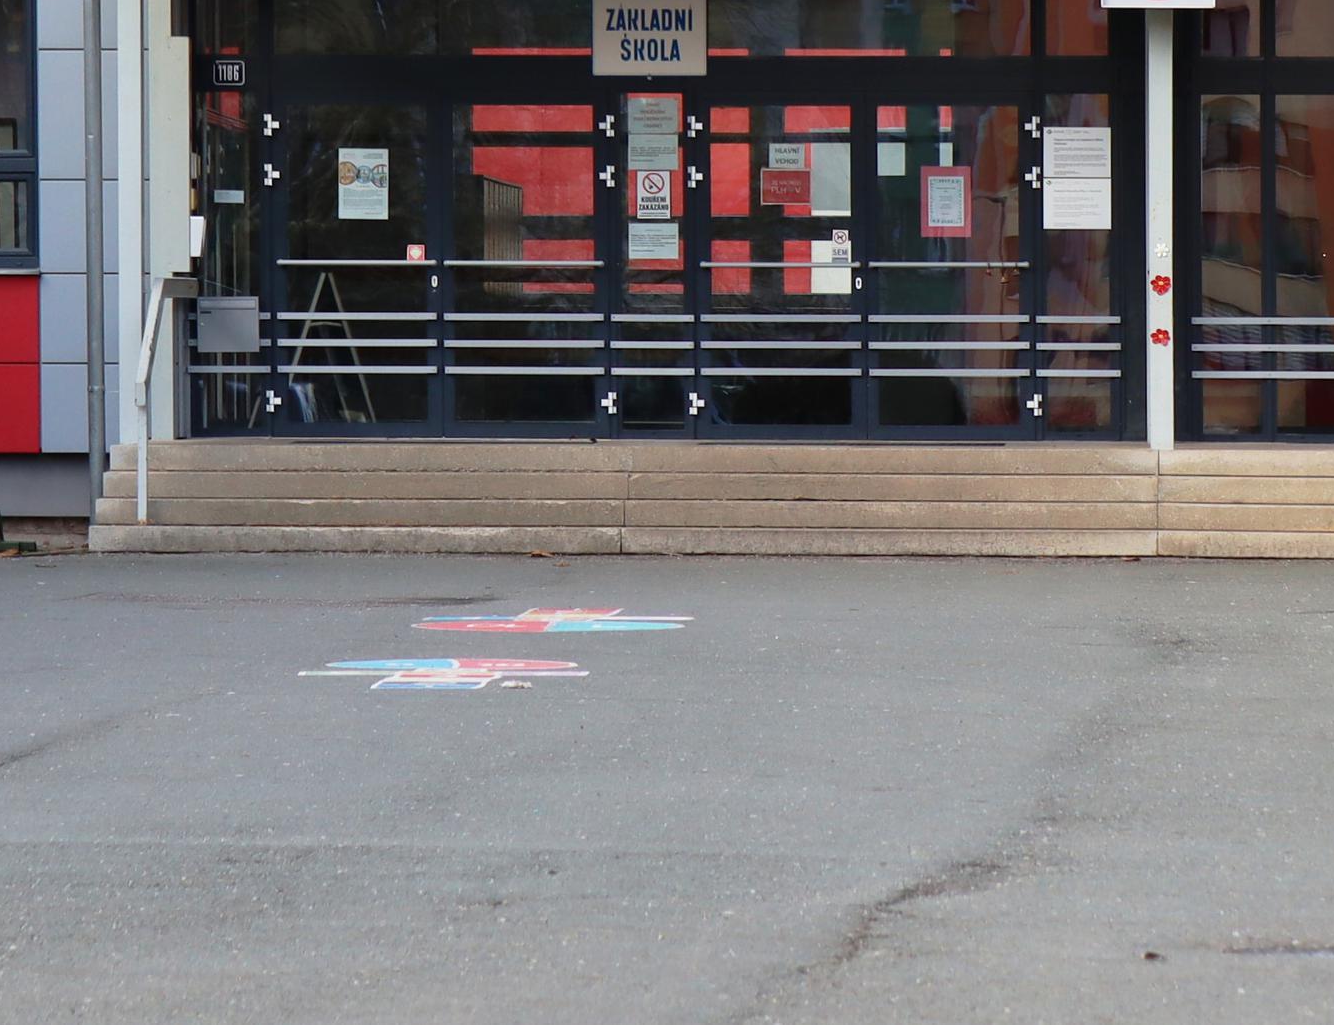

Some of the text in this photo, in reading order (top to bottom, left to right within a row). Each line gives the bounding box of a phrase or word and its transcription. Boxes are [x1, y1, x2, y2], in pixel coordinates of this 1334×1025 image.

[606, 4, 692, 31] ZÁKLADNÍ
[621, 33, 680, 61] ŠKOLA
[218, 64, 239, 81] 1186
